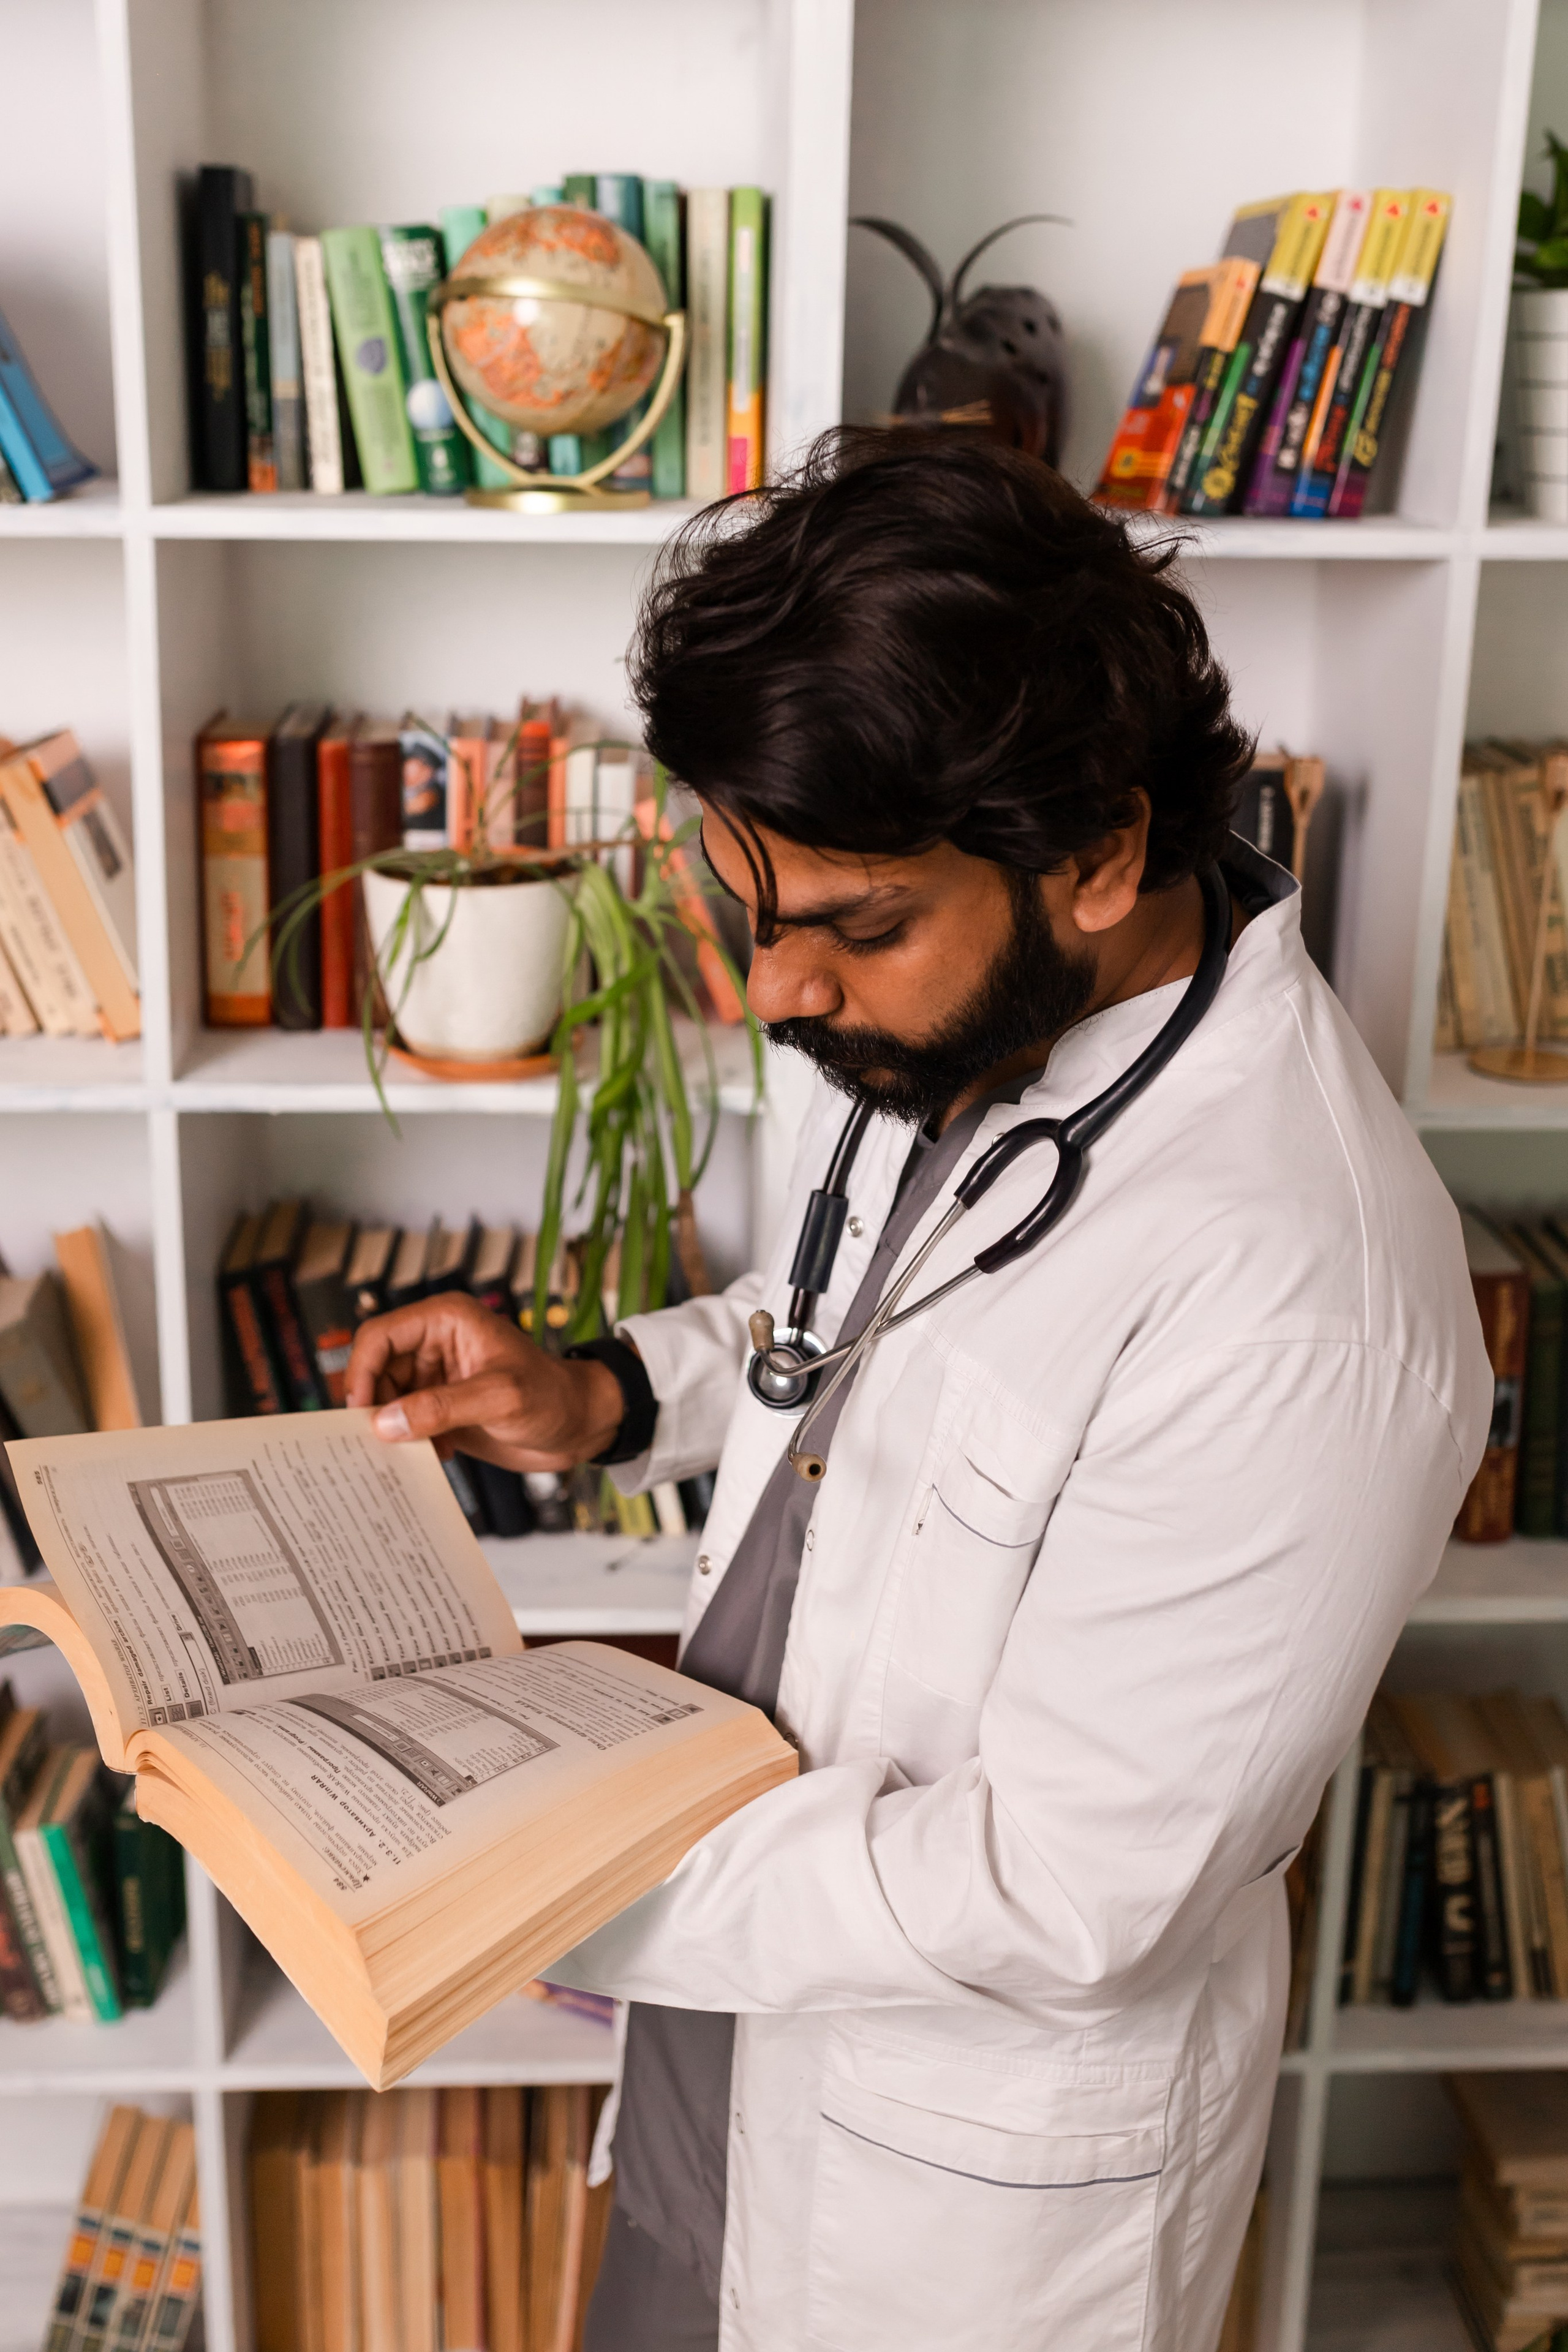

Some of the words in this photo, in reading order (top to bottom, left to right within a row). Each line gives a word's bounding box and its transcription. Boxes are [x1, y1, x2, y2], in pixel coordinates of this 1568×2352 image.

[113, 1620, 128, 1642] archive
[171, 1614, 182, 1630] Drive
[126, 1645, 143, 1676] damaged
[141, 1680, 153, 1705] Repair
[163, 1687, 172, 1701] List
[178, 1672, 190, 1698] Details
[514, 1700, 543, 1714] WinRAR
[545, 1713, 587, 1737] архиватора
[218, 1735, 254, 1762] используемые
[318, 1736, 343, 1755] архивами
[587, 1736, 607, 1750] Окно
[254, 1763, 268, 1777] часто
[261, 1760, 281, 1777] следует
[296, 1747, 328, 1773] необходимо
[307, 1746, 341, 1773] Программы
[348, 1759, 368, 1775] работе
[326, 1773, 350, 1795] WinRAR
[341, 1774, 356, 1787] меню
[369, 1770, 383, 1781] этой
[270, 1777, 293, 1801] наиболее
[290, 1787, 312, 1808] поэтому
[311, 1774, 337, 1800] WinRAR
[375, 1783, 399, 1805] действия
[384, 1782, 398, 1795] окно
[417, 1781, 437, 1800] WinRAR
[351, 1795, 380, 1824] программы
[358, 1789, 381, 1811] главного
[373, 1793, 407, 1826] пиктограмме
[399, 1796, 413, 1811] через
[418, 1804, 431, 1815] (рис.
[294, 1802, 312, 1820] только
[314, 1809, 334, 1831] файлов,
[339, 1801, 375, 1836] Архиватор
[382, 1812, 398, 1829] пункт
[399, 1806, 424, 1831] основные
[380, 1824, 400, 1845] запуска
[415, 1812, 443, 1839] ствляются
[431, 1817, 451, 1835] робнее
[312, 1821, 347, 1856] перечислены
[400, 1830, 421, 1852] выбрать
[416, 1835, 428, 1848] нуть
[425, 1833, 436, 1844] Все
[334, 1832, 372, 1870] разархивации
[378, 1839, 401, 1864] 11.3.2.
[401, 1846, 413, 1858] Для
[349, 1858, 363, 1874] Здесь
